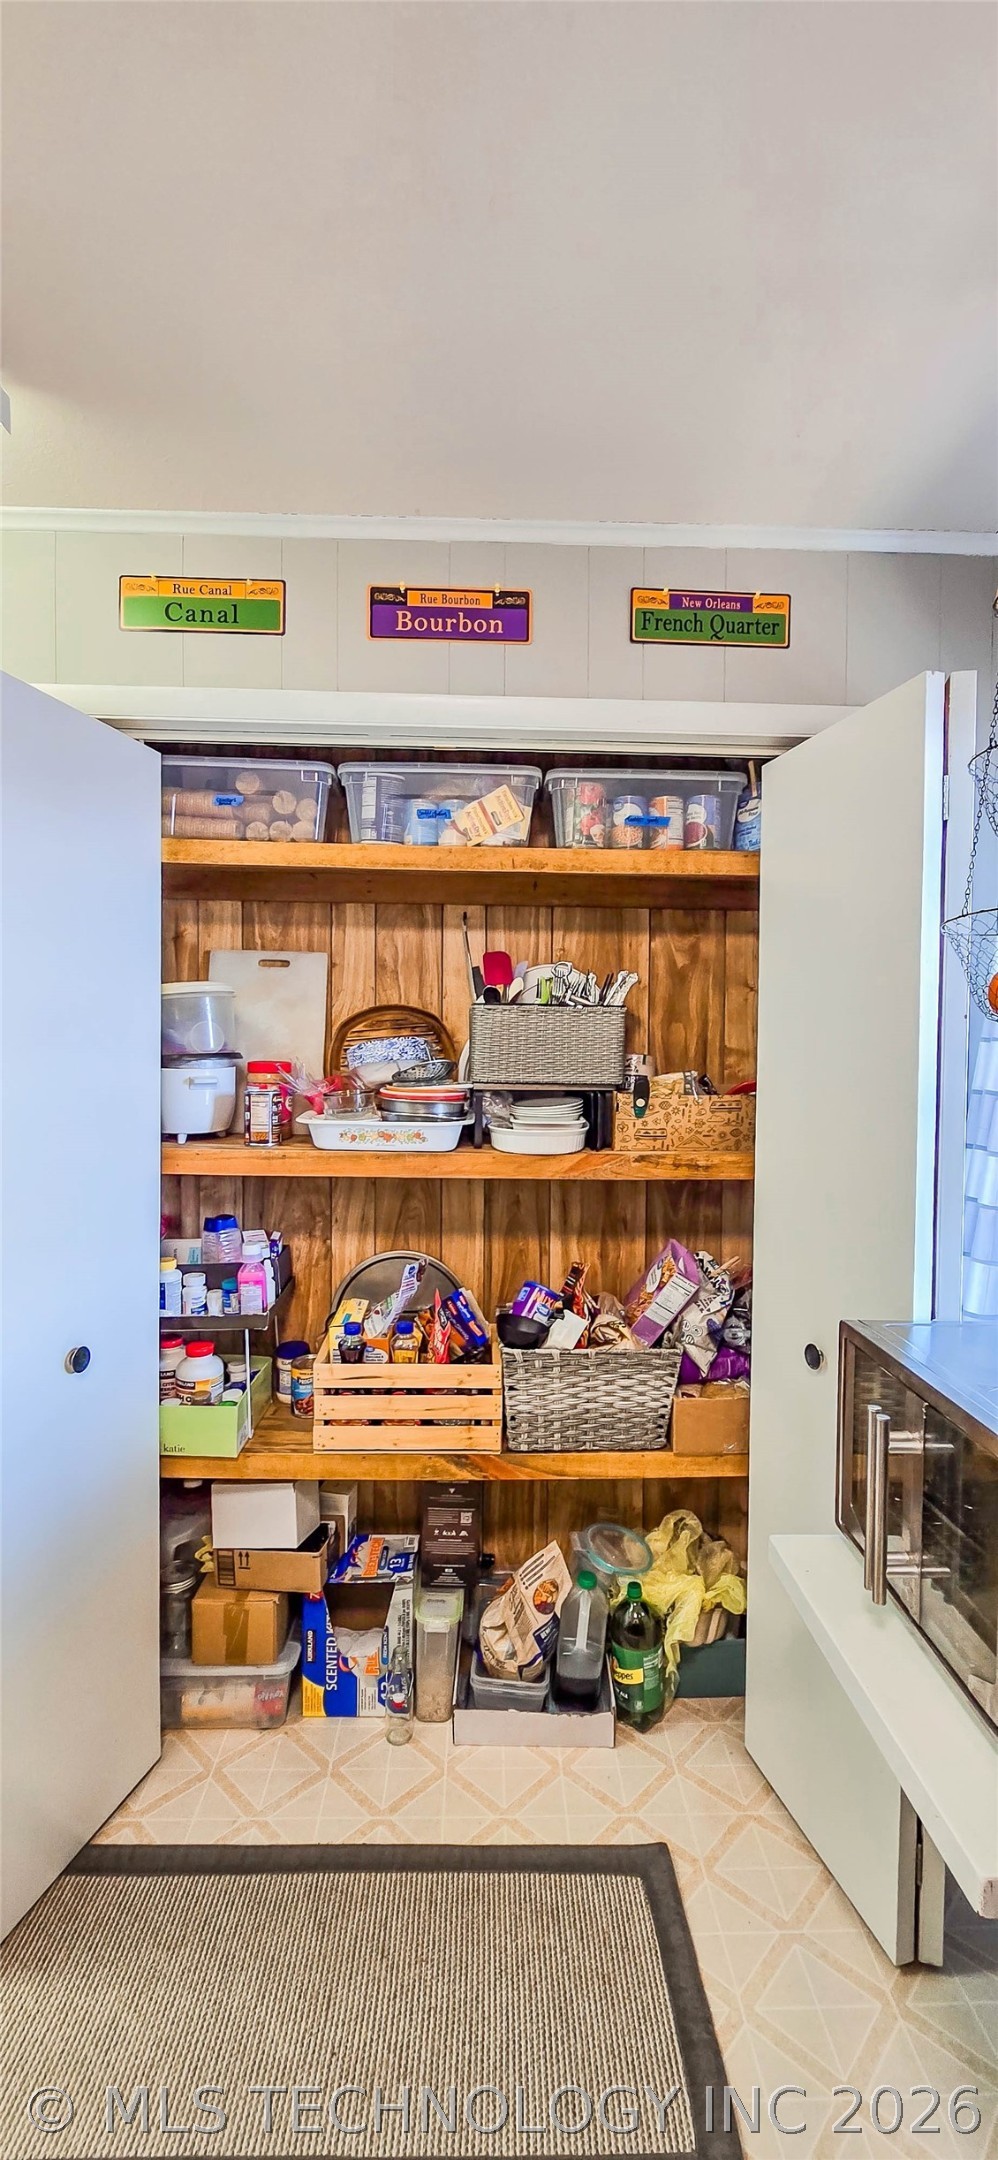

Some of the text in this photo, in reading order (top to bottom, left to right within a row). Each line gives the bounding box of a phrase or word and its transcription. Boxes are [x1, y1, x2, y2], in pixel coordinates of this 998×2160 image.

[172, 583, 233, 596] Rue Canal
[420, 593, 481, 606] Rue Bourbon
[681, 596, 741, 610] New Orleans
[164, 602, 240, 624] Canal
[395, 610, 504, 634] Bourbon
[641, 610, 780, 641] French Quarter
[389, 1558, 402, 1569] 13
[326, 1637, 338, 1691] SCENTED
